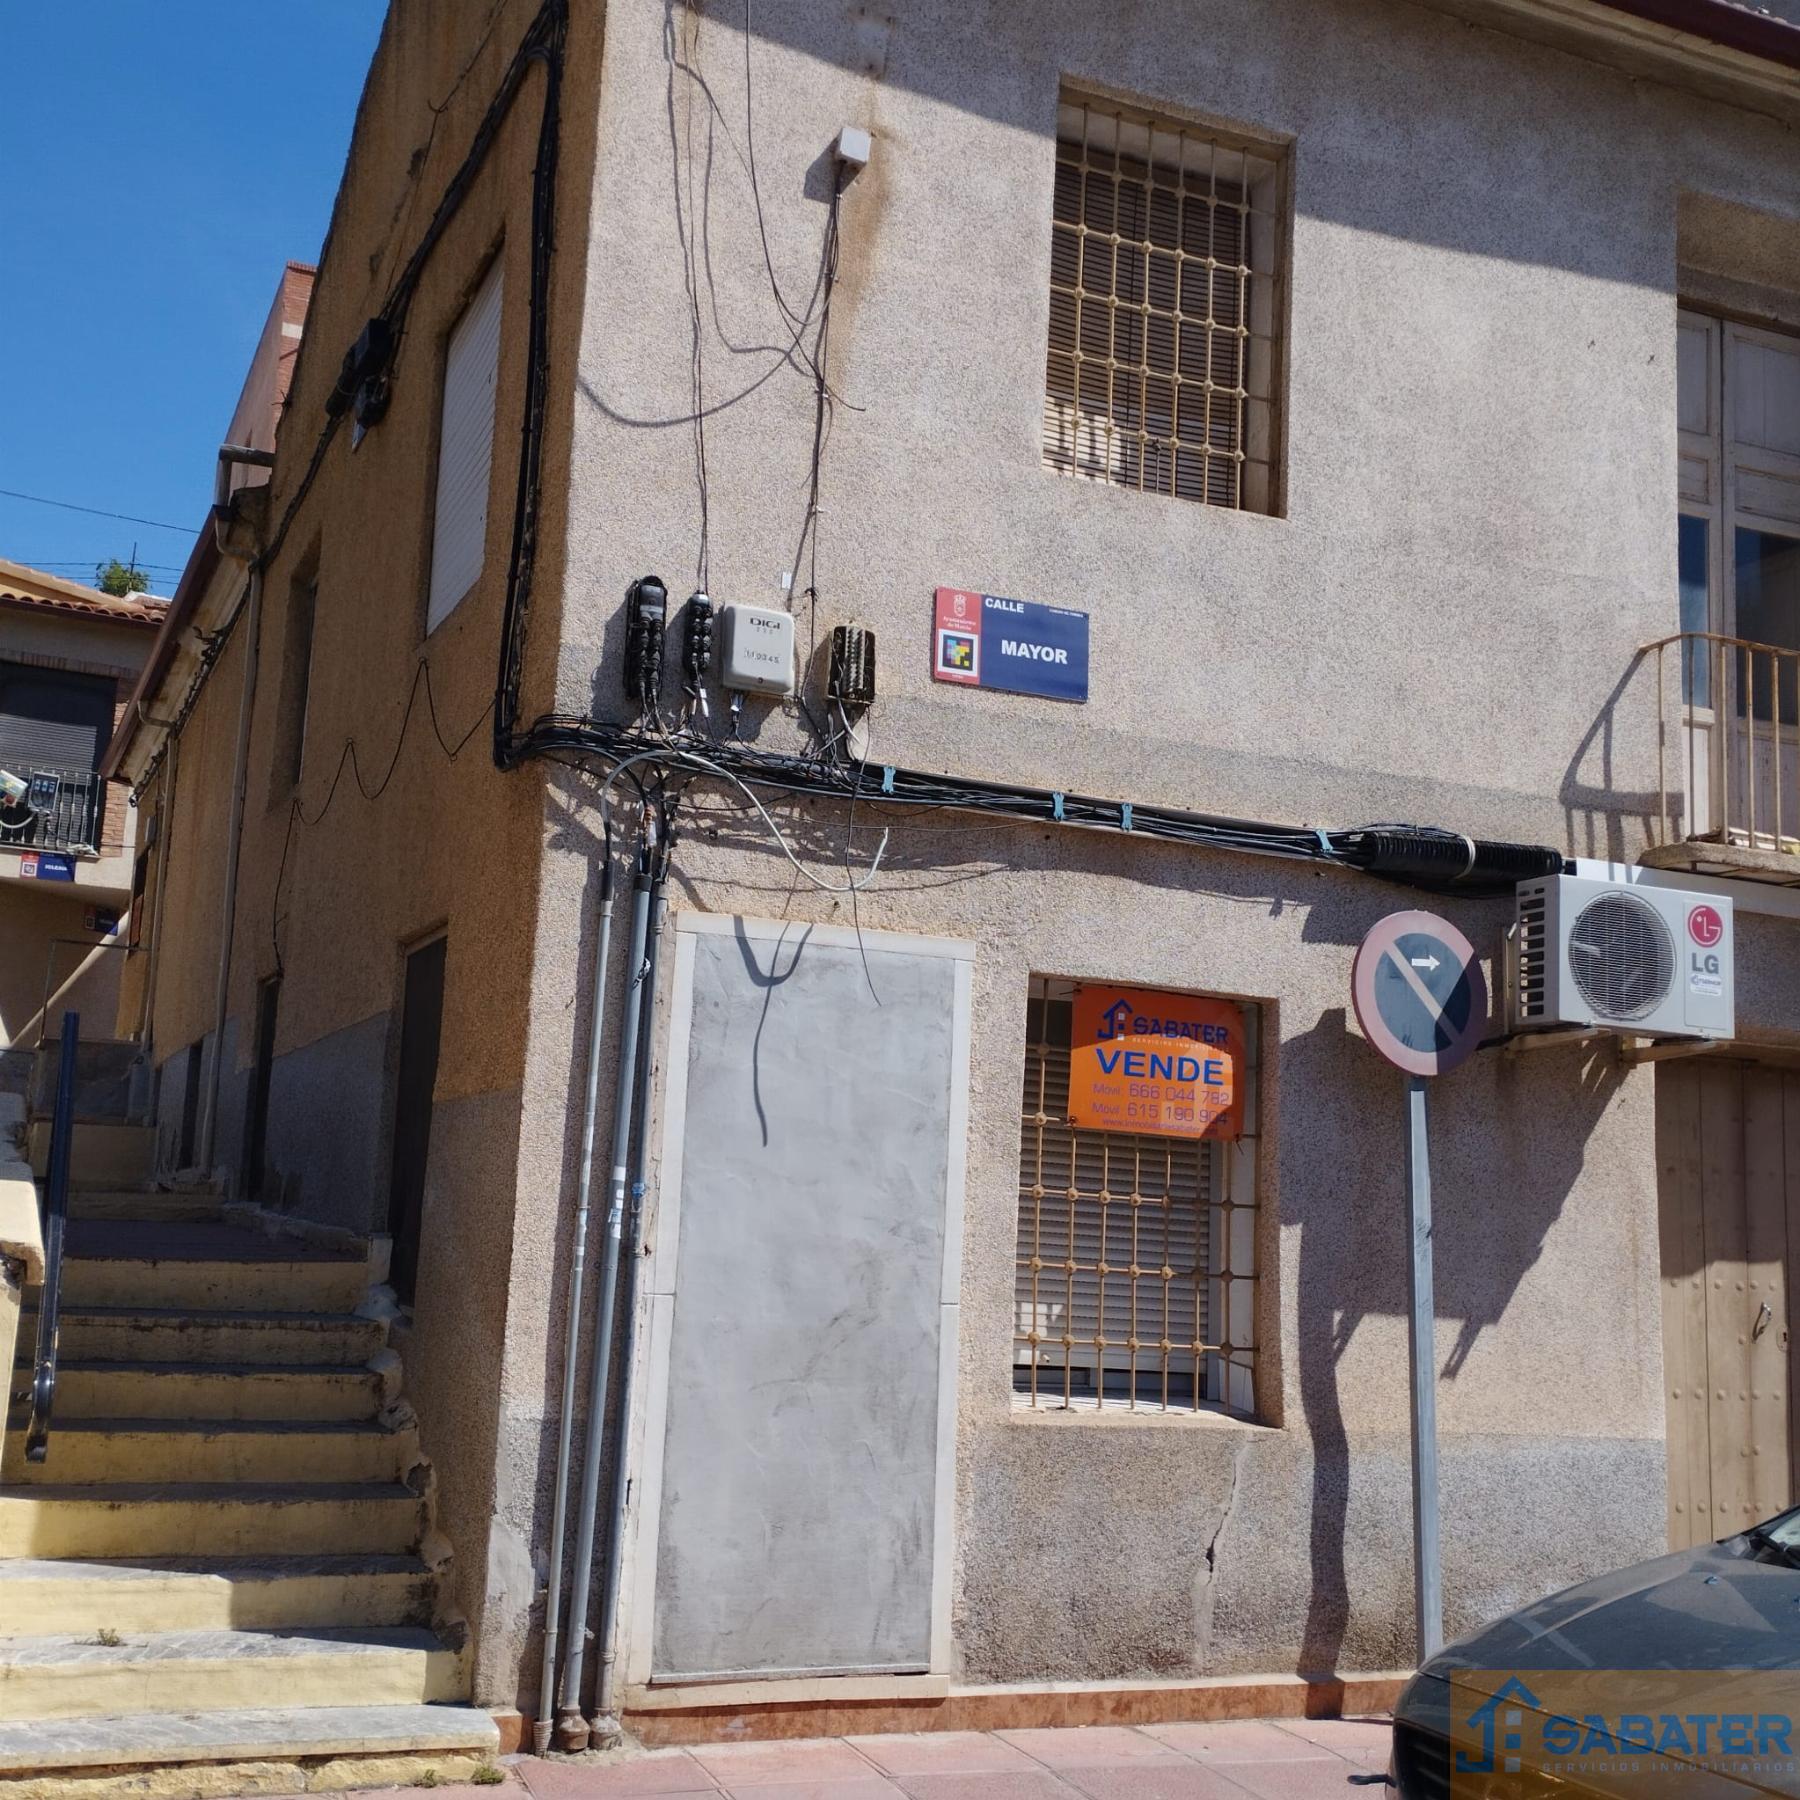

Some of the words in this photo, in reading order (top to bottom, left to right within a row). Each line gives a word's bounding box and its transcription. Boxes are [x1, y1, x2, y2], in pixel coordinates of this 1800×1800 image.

[985, 598, 1024, 613] CALLE
[750, 617, 780, 630] DIGI
[1001, 640, 1068, 664] MAYOR
[1692, 952, 1719, 974] LG
[1133, 1016, 1229, 1045] SABATER
[1096, 1048, 1224, 1086] VENDE
[1129, 1083, 1160, 1100] 666
[1165, 1087, 1195, 1102] 044
[1200, 1090, 1230, 1106] 782
[1127, 1102, 1158, 1118] 615
[1166, 1106, 1194, 1121] 190
[1200, 1109, 1228, 1124] 904
